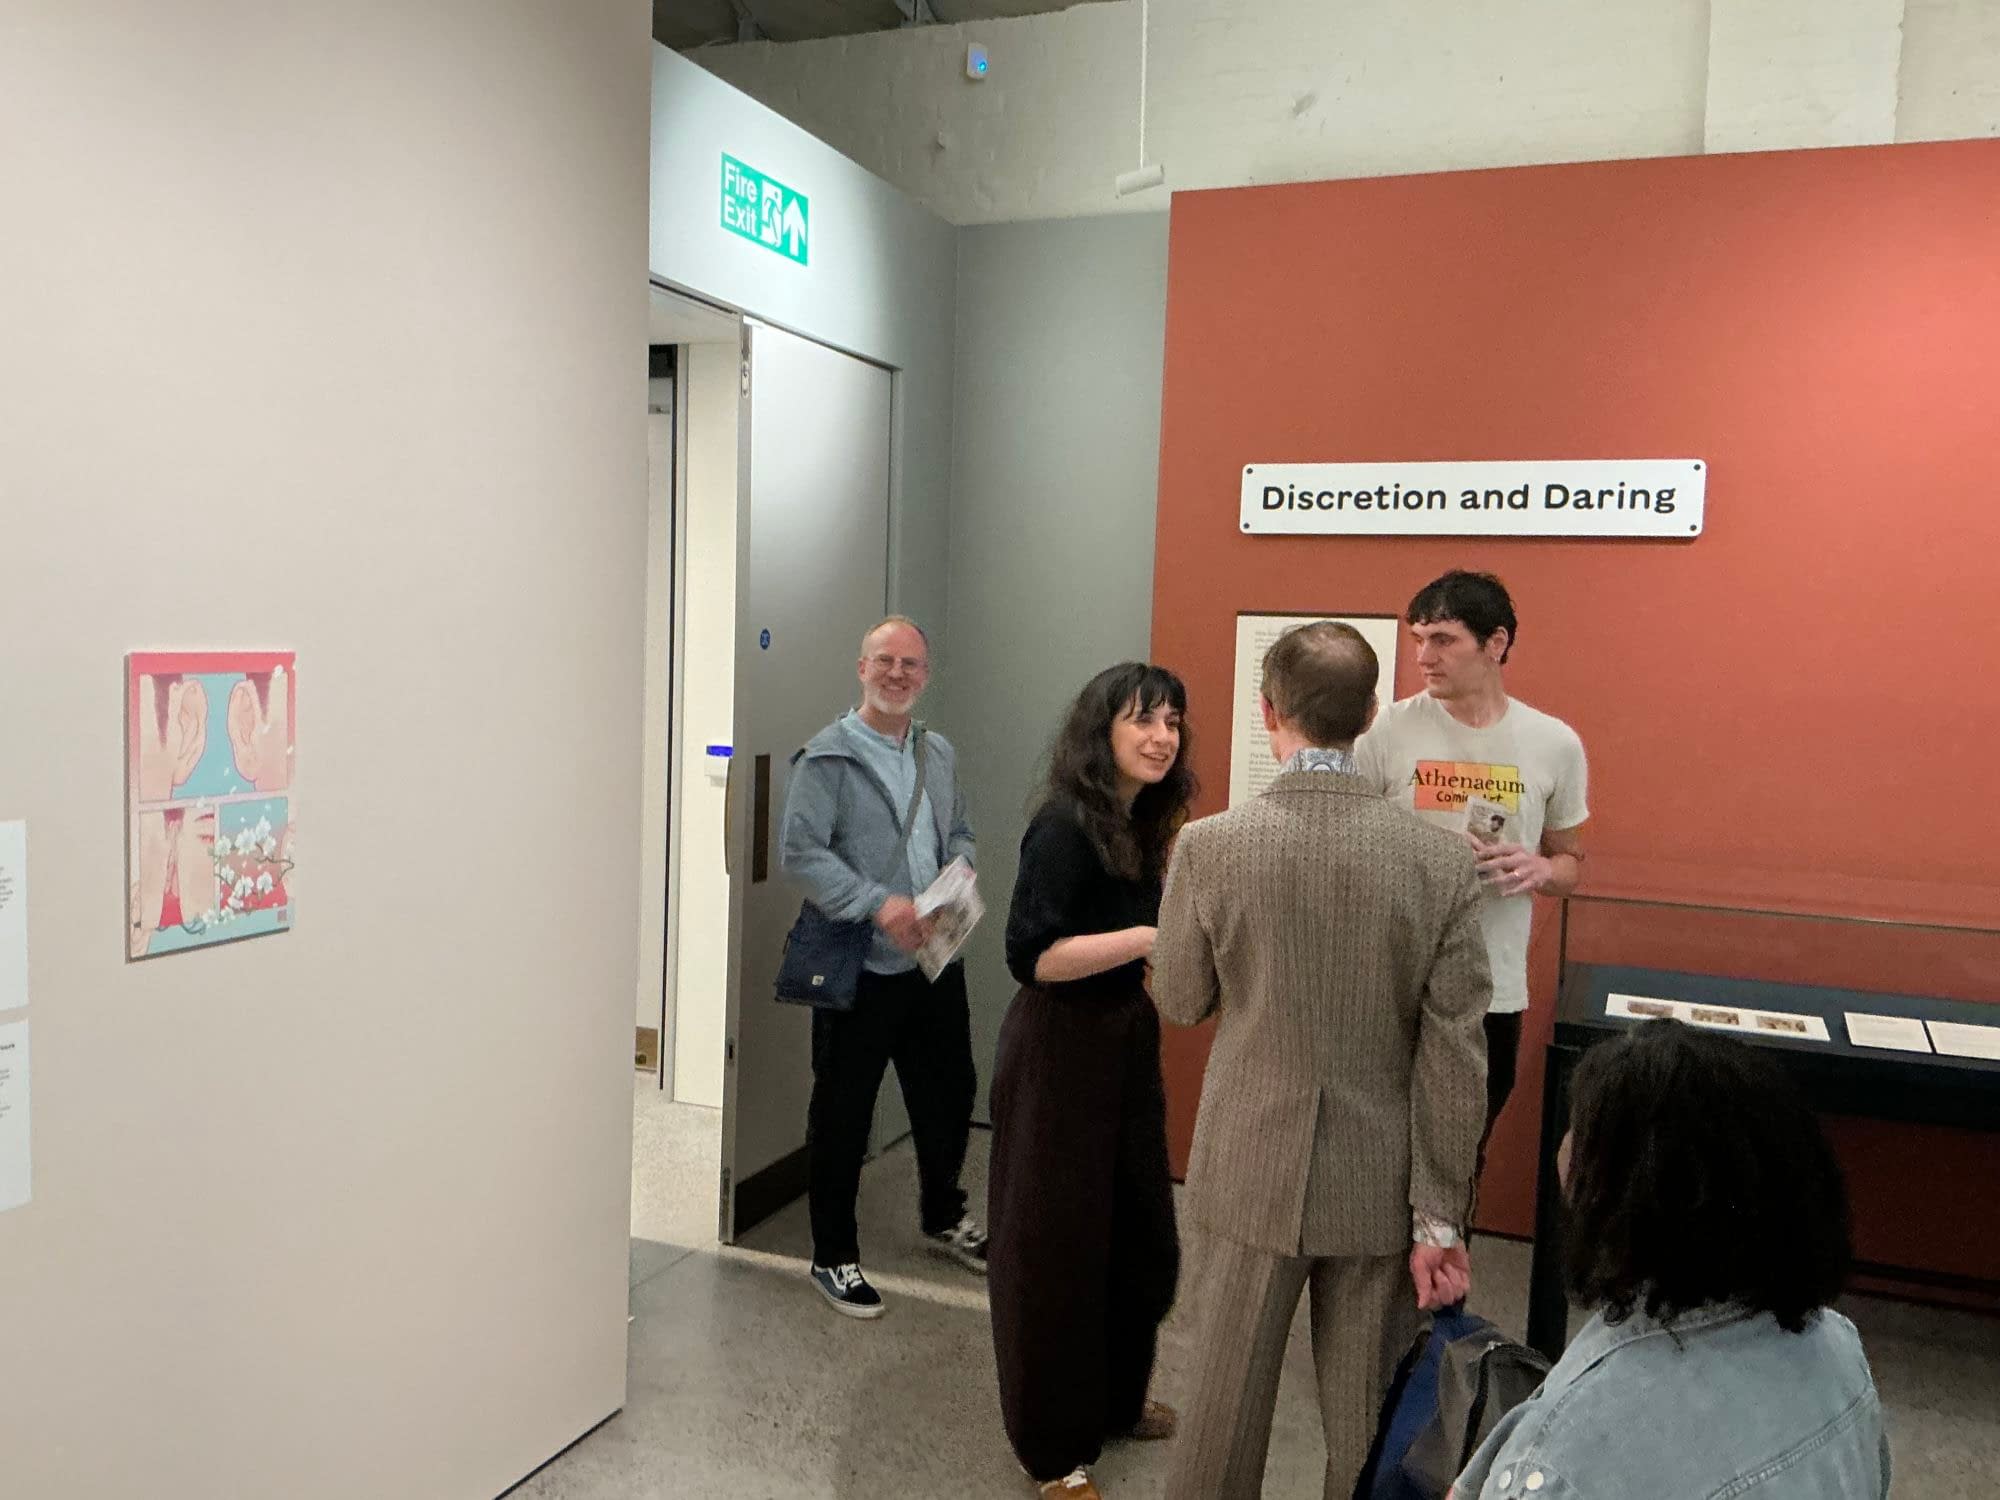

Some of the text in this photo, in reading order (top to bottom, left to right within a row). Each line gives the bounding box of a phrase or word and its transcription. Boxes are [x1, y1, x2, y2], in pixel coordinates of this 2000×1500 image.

[724, 161, 758, 204] Fire
[724, 193, 758, 238] Exit
[1262, 481, 1677, 514] Discretion and Daring
[1408, 767, 1526, 793] Athenaeum
